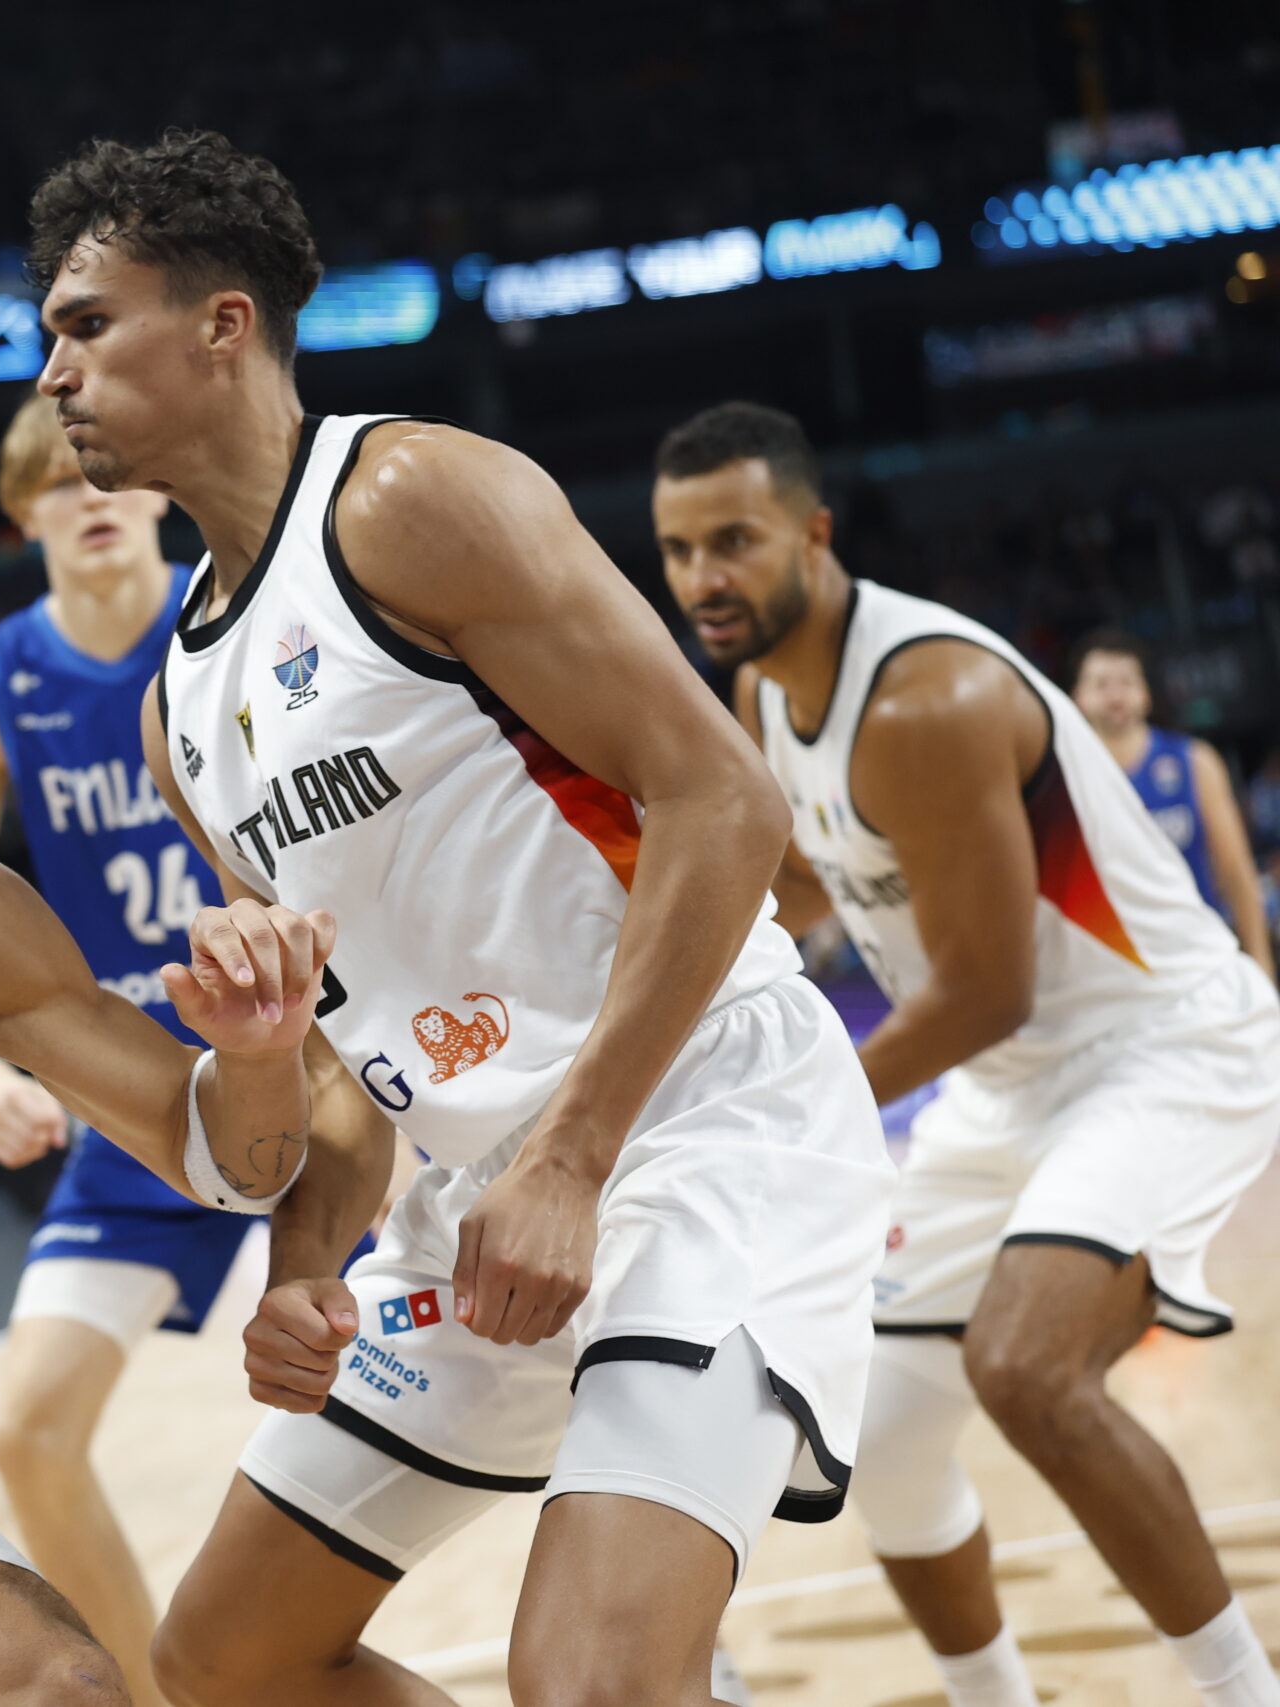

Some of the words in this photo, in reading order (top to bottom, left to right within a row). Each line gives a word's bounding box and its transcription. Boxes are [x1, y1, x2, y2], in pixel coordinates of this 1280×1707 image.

[286, 683, 319, 711] 25
[348, 1354, 402, 1400] Pizza
[352, 1332, 430, 1393] omino's
